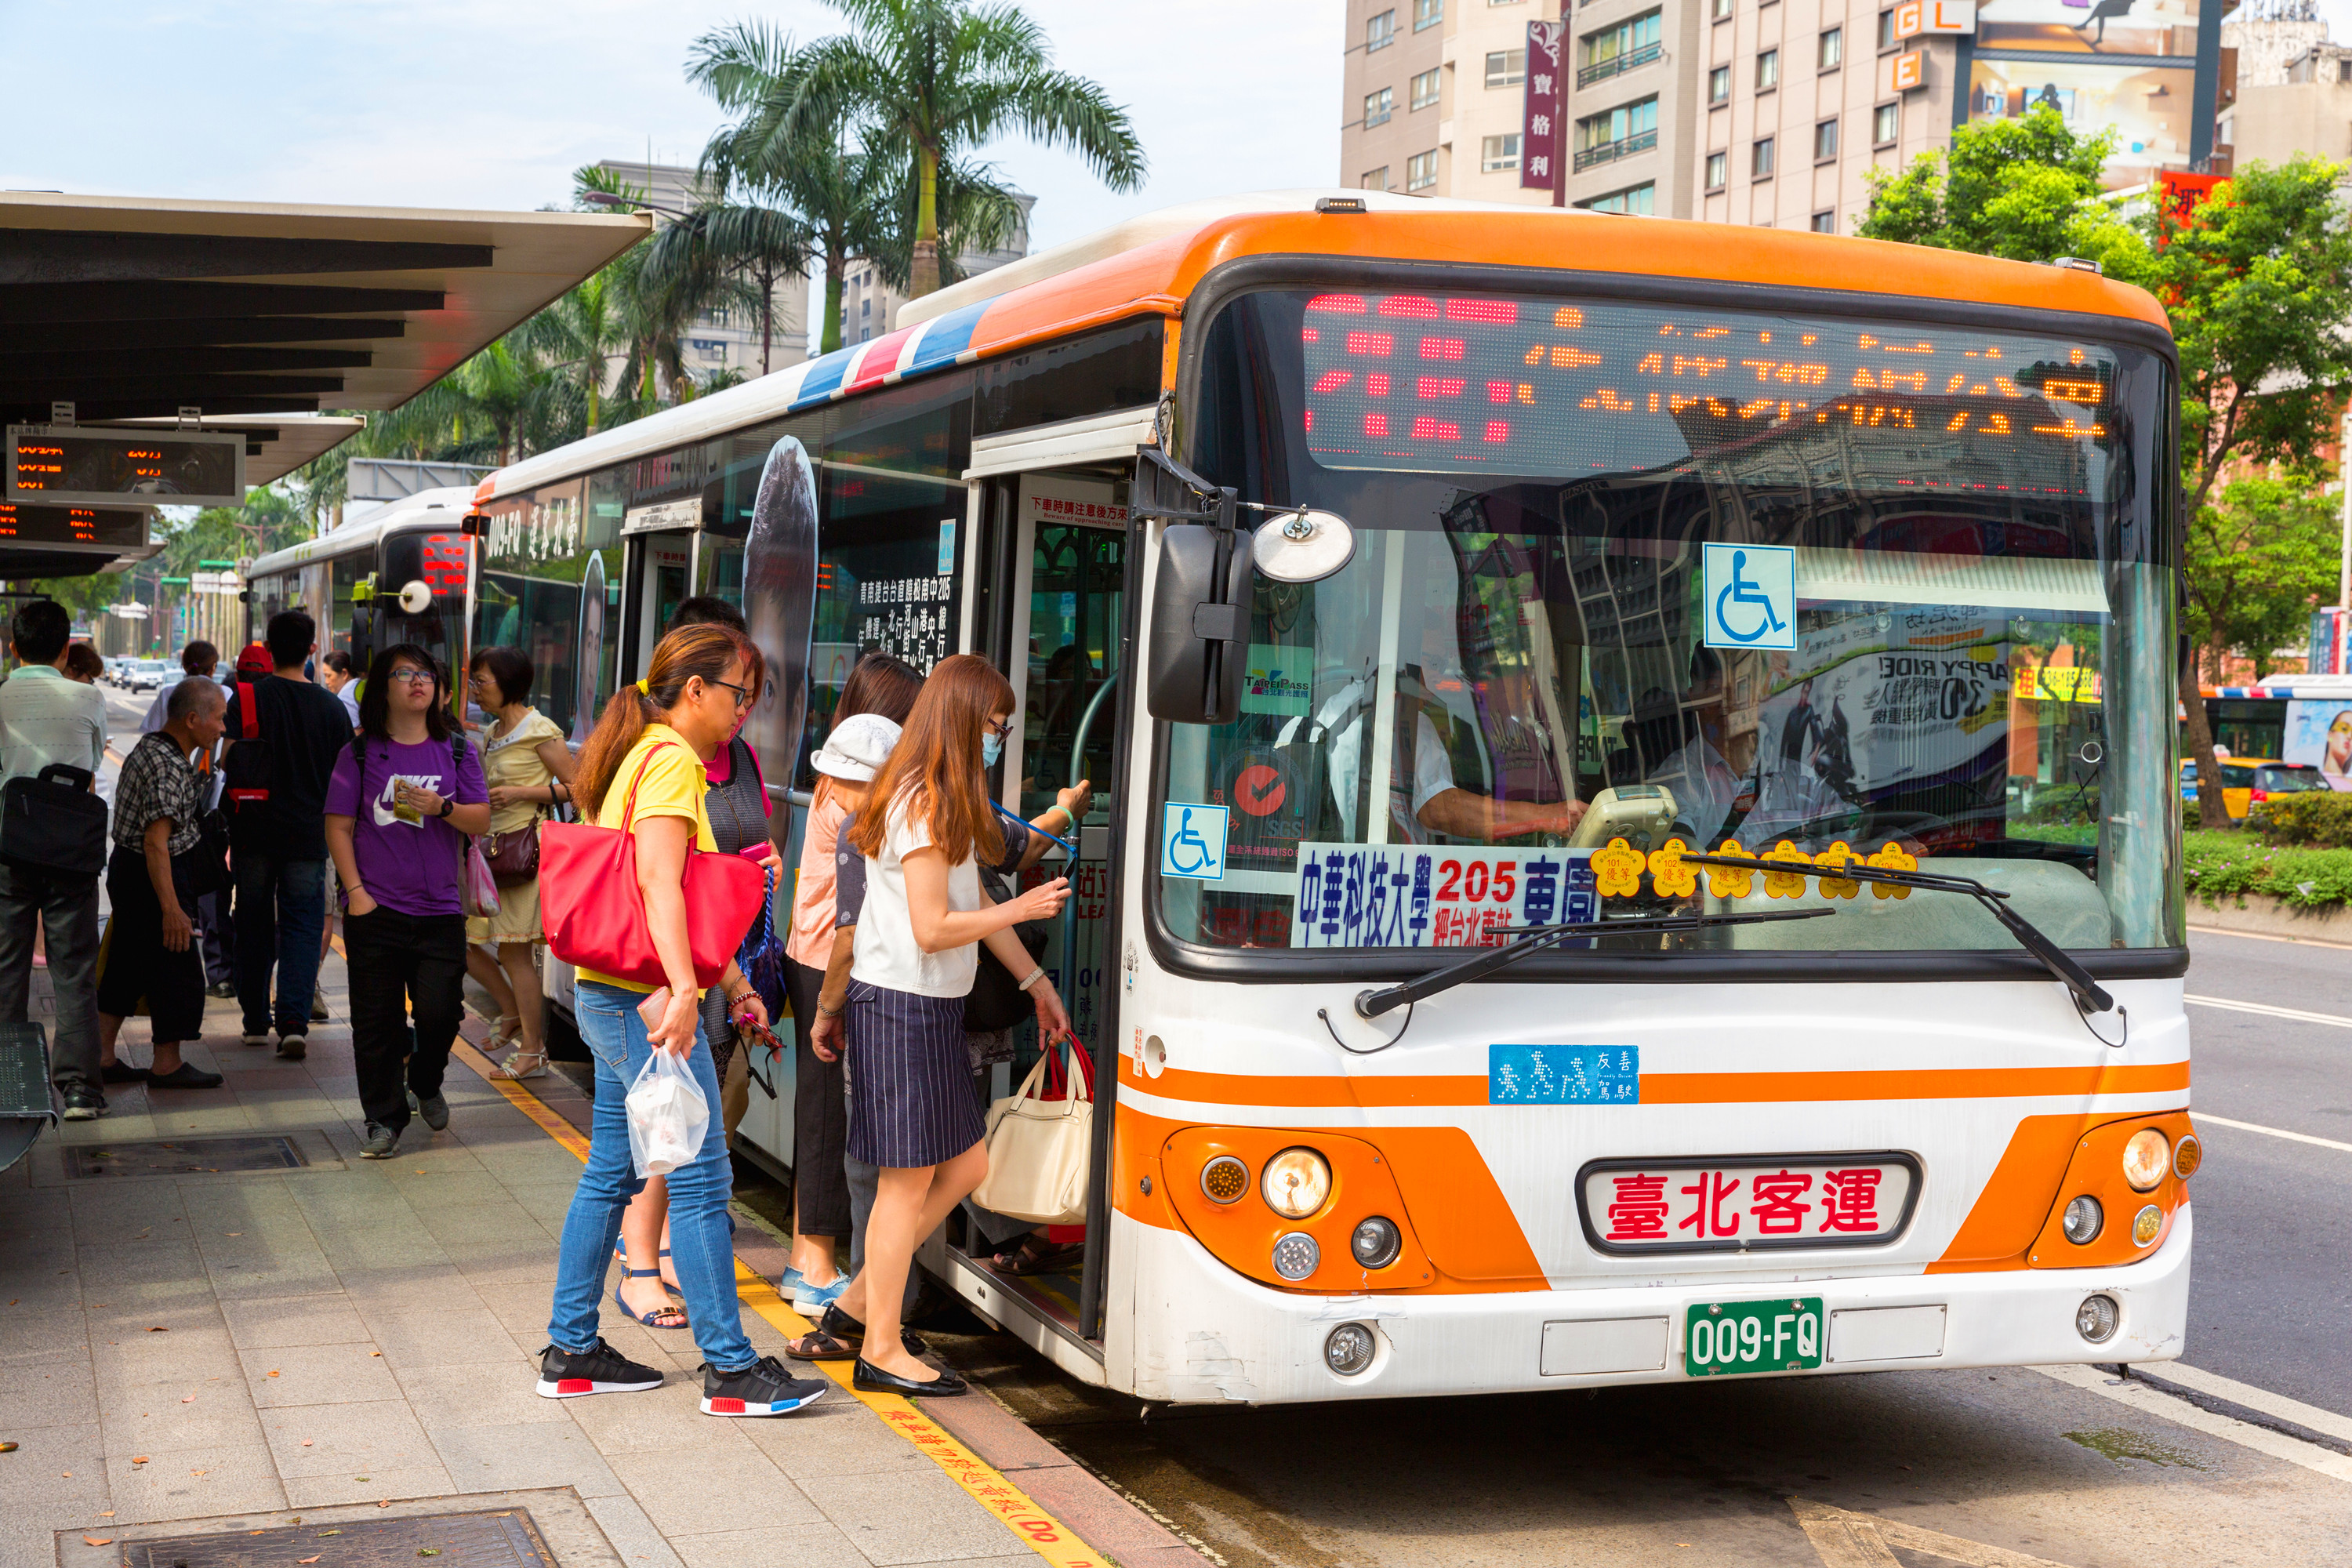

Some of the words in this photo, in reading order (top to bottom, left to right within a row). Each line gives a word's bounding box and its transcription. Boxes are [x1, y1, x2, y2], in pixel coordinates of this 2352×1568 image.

[1528, 72, 1553, 177] 寶格利
[1044, 512, 1065, 521] Beware
[1074, 517, 1111, 527] approaching
[488, 510, 521, 557] 009-FQ
[1261, 688, 1308, 699] 台北觀光護照
[1268, 819, 1301, 839] SGS
[1435, 858, 1517, 902] 205
[1606, 867, 1631, 880] 優等
[1663, 868, 1687, 882] 優等
[1718, 869, 1743, 882] 優等
[1299, 849, 1431, 949] 中華科技大學
[1433, 906, 1513, 948] 經台北車站
[1597, 1051, 1632, 1072] 友善
[1597, 1080, 1633, 1100] 駕駛
[1606, 1168, 1882, 1240] 臺北客運
[1692, 1312, 1818, 1366] 009-FQ
